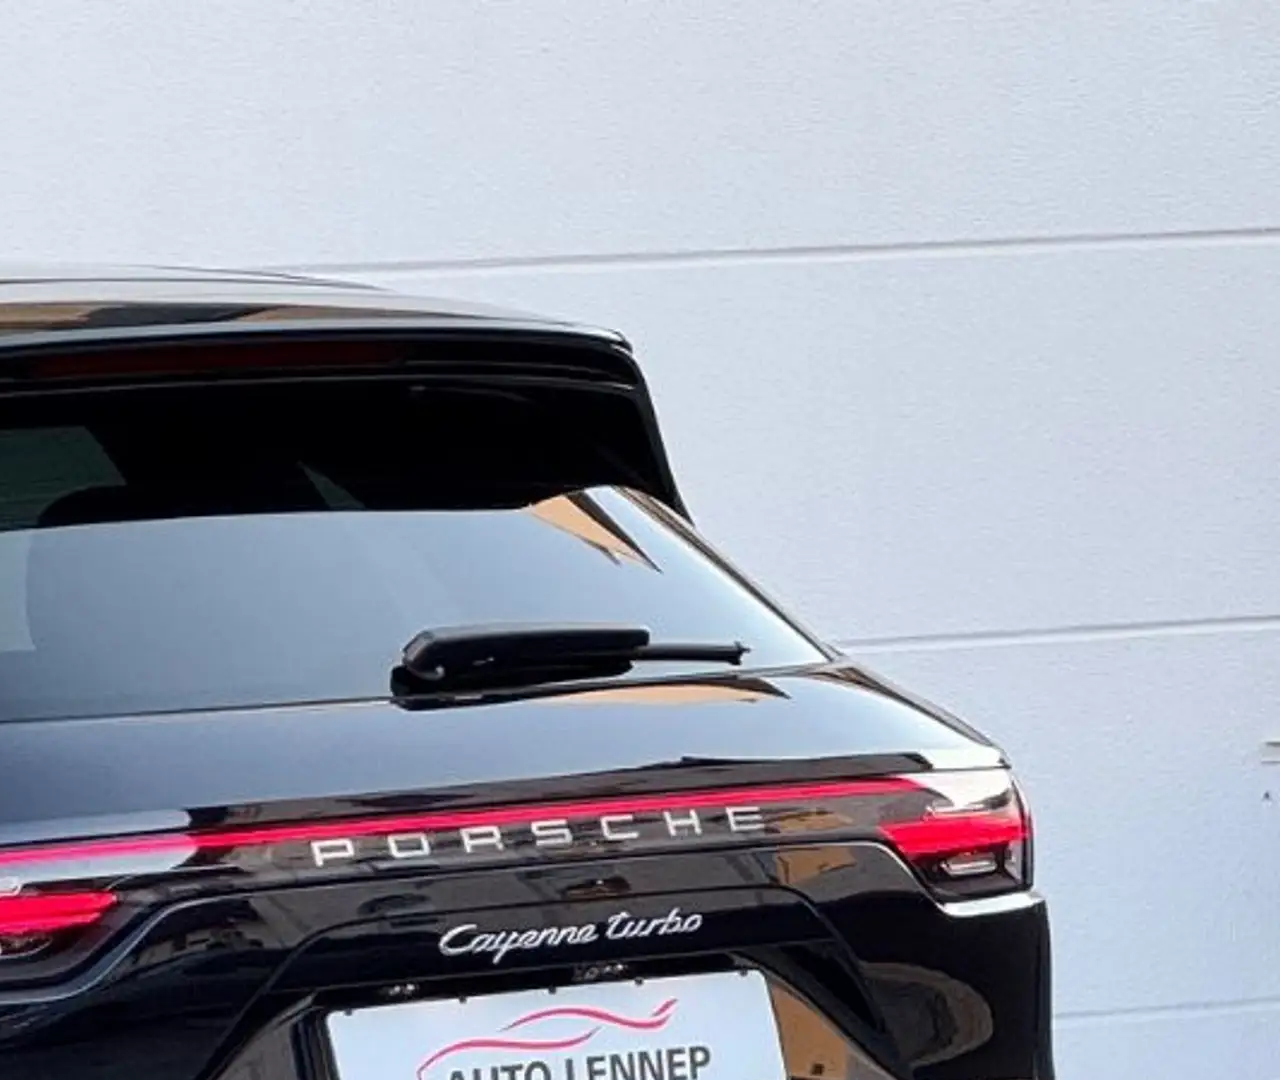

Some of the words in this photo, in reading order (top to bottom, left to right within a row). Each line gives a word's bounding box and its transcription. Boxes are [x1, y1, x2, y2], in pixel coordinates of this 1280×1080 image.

[310, 806, 765, 866] PORSCHE
[438, 923, 599, 965] Cayenne
[605, 907, 703, 940] turbo
